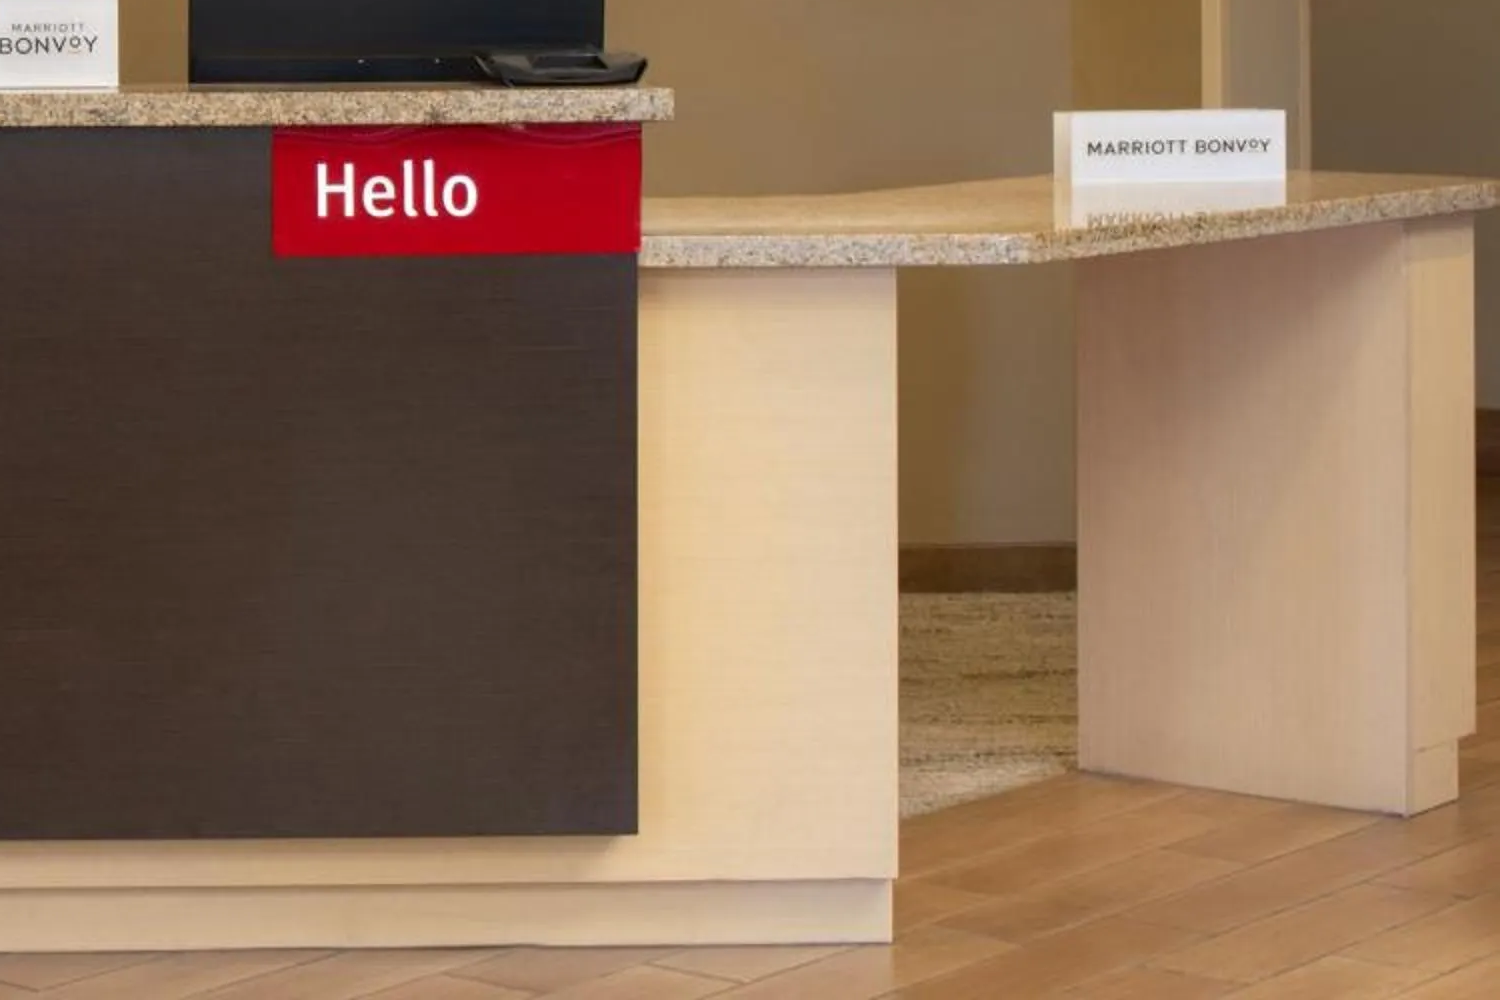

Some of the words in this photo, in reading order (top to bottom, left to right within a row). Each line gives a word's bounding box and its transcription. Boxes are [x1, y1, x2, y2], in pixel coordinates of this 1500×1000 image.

[11, 23, 85, 33] MARRIOTT
[1086, 138, 1189, 157] MARRIOTT
[316, 158, 478, 218] Hello
